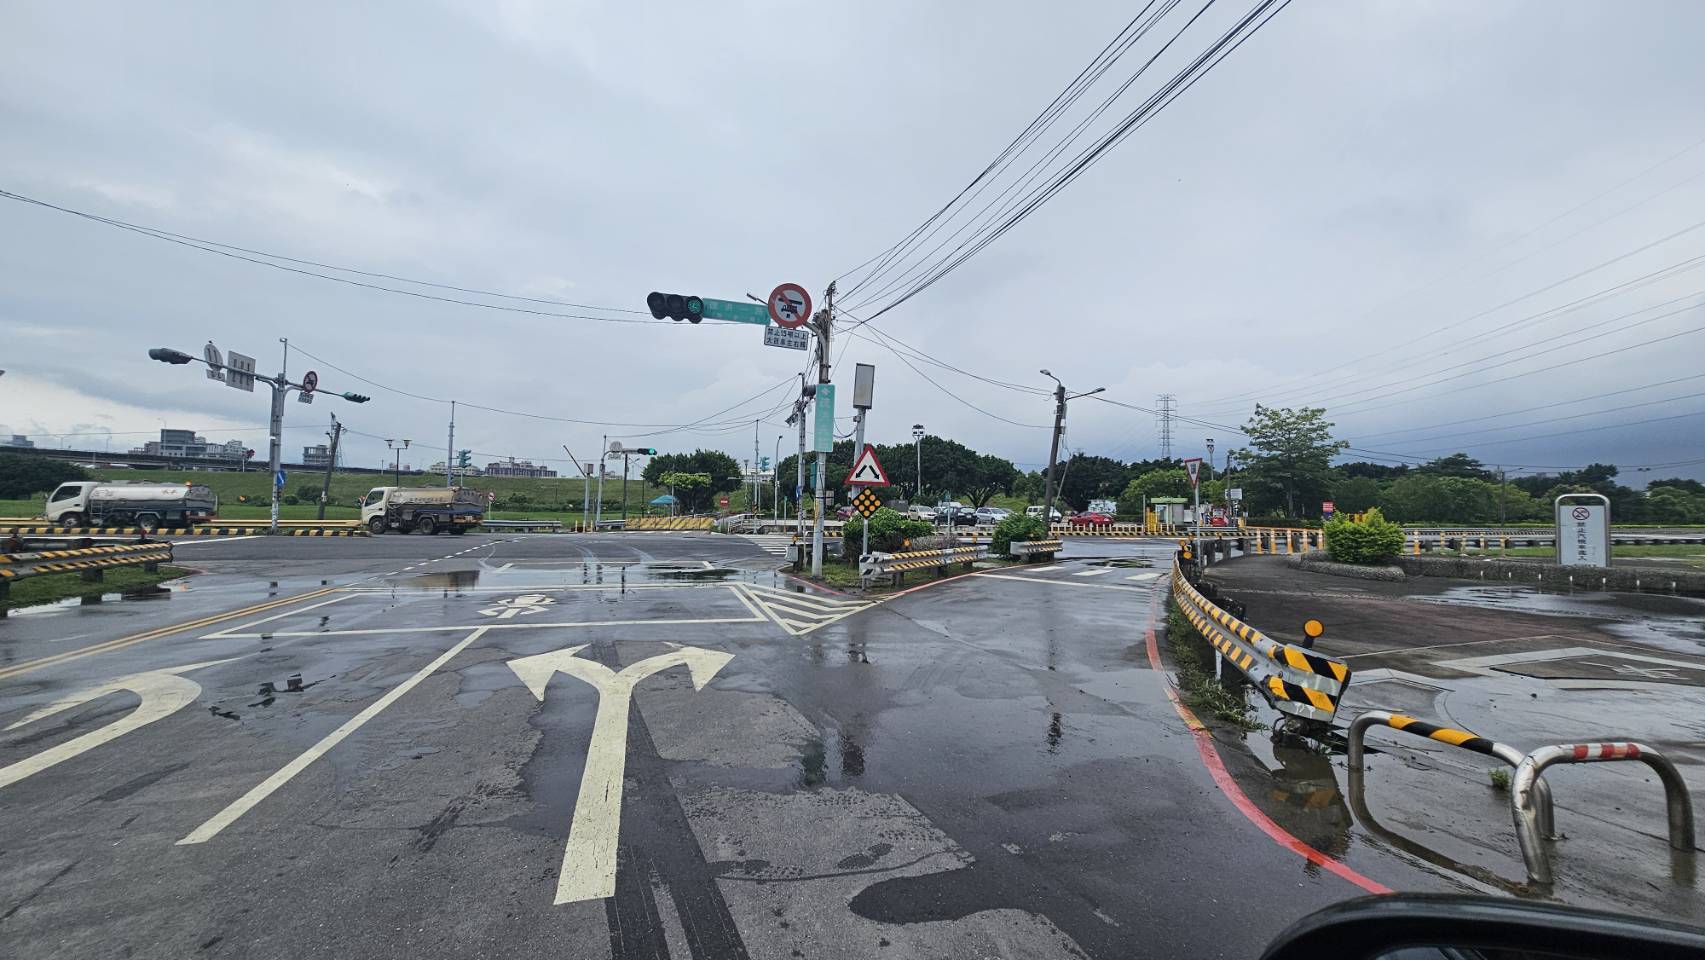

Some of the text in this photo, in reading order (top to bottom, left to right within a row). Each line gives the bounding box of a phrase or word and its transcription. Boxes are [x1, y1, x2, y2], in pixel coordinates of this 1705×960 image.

[1576, 522, 1588, 561] 禁止汽機車進入
